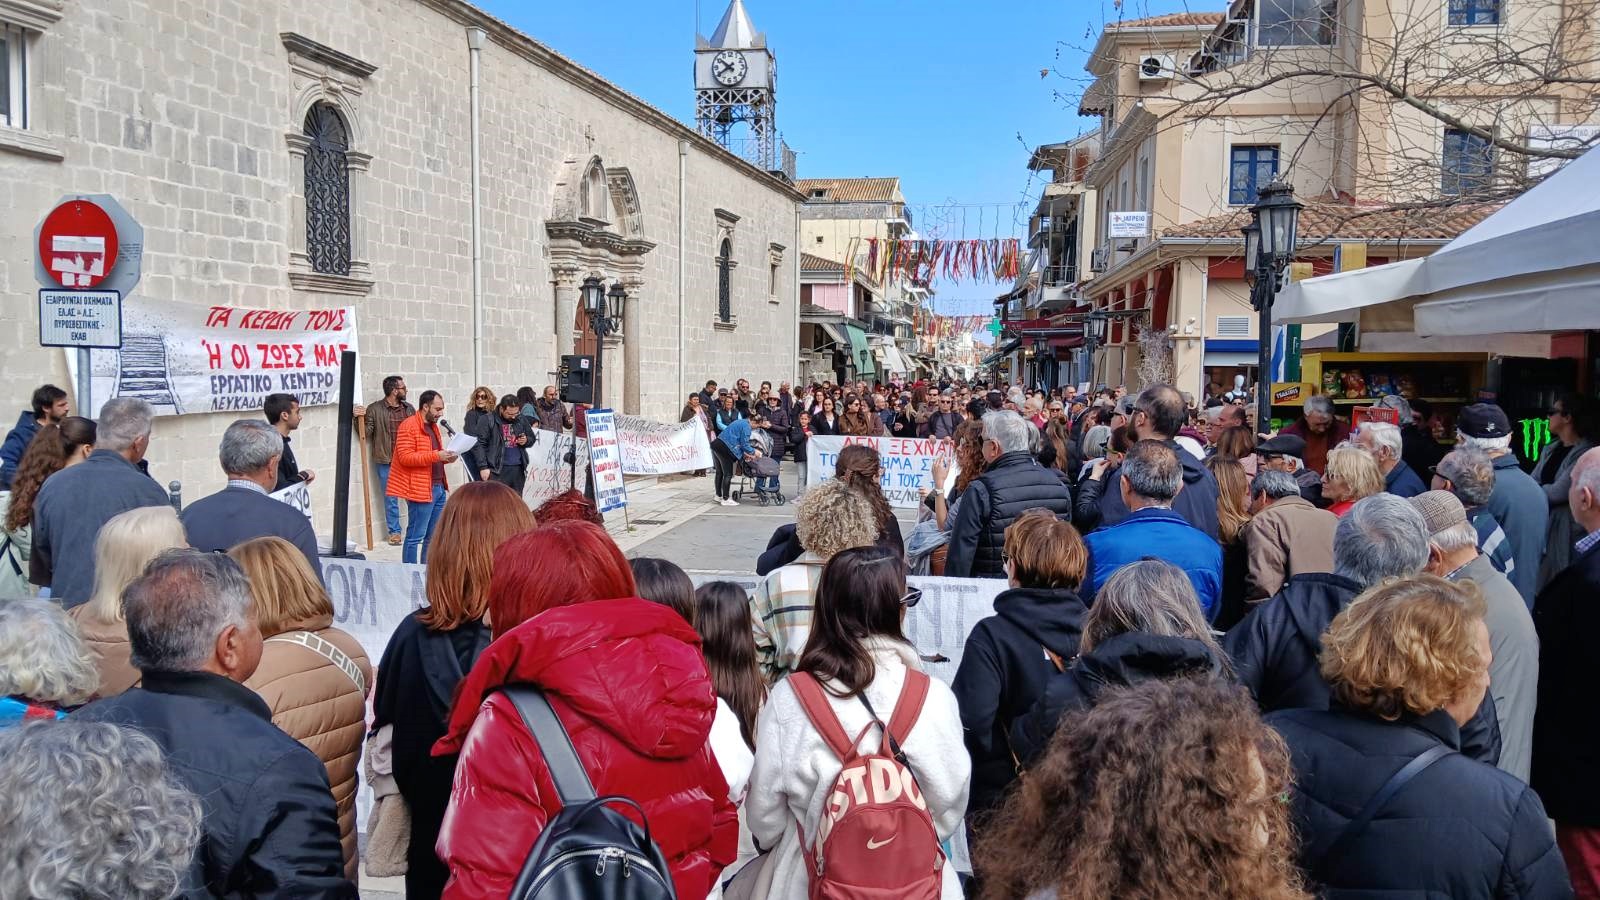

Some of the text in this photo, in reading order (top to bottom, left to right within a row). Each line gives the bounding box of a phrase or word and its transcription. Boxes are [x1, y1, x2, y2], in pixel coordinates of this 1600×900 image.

[46, 295, 113, 305] ΕΞΑΙΡΟΥΝΤΑΙ ΟΧΗΜΑΤΑ
[54, 319, 100, 329] ΠΥΡΟΣΒΕΣΤΙΚΗΣ
[206, 306, 346, 331] ΤΑ ΚΕΡΔΗ ΤΟΥΣ
[71, 332, 87, 341] ΕΚΑΒ
[231, 344, 250, 369] ΟΙ
[257, 343, 306, 369] ΖΩΕΣ
[210, 371, 334, 395] ΕΡΓΑΤΙΚΟ ΚΕΝΤΡΟ
[210, 390, 329, 411] ΛΕΥΚΑΔΑ ΝΙΤΣΑΣ
[881, 456, 913, 470] ΗΜΑ
[897, 473, 924, 488] ΤΟΥΣ
